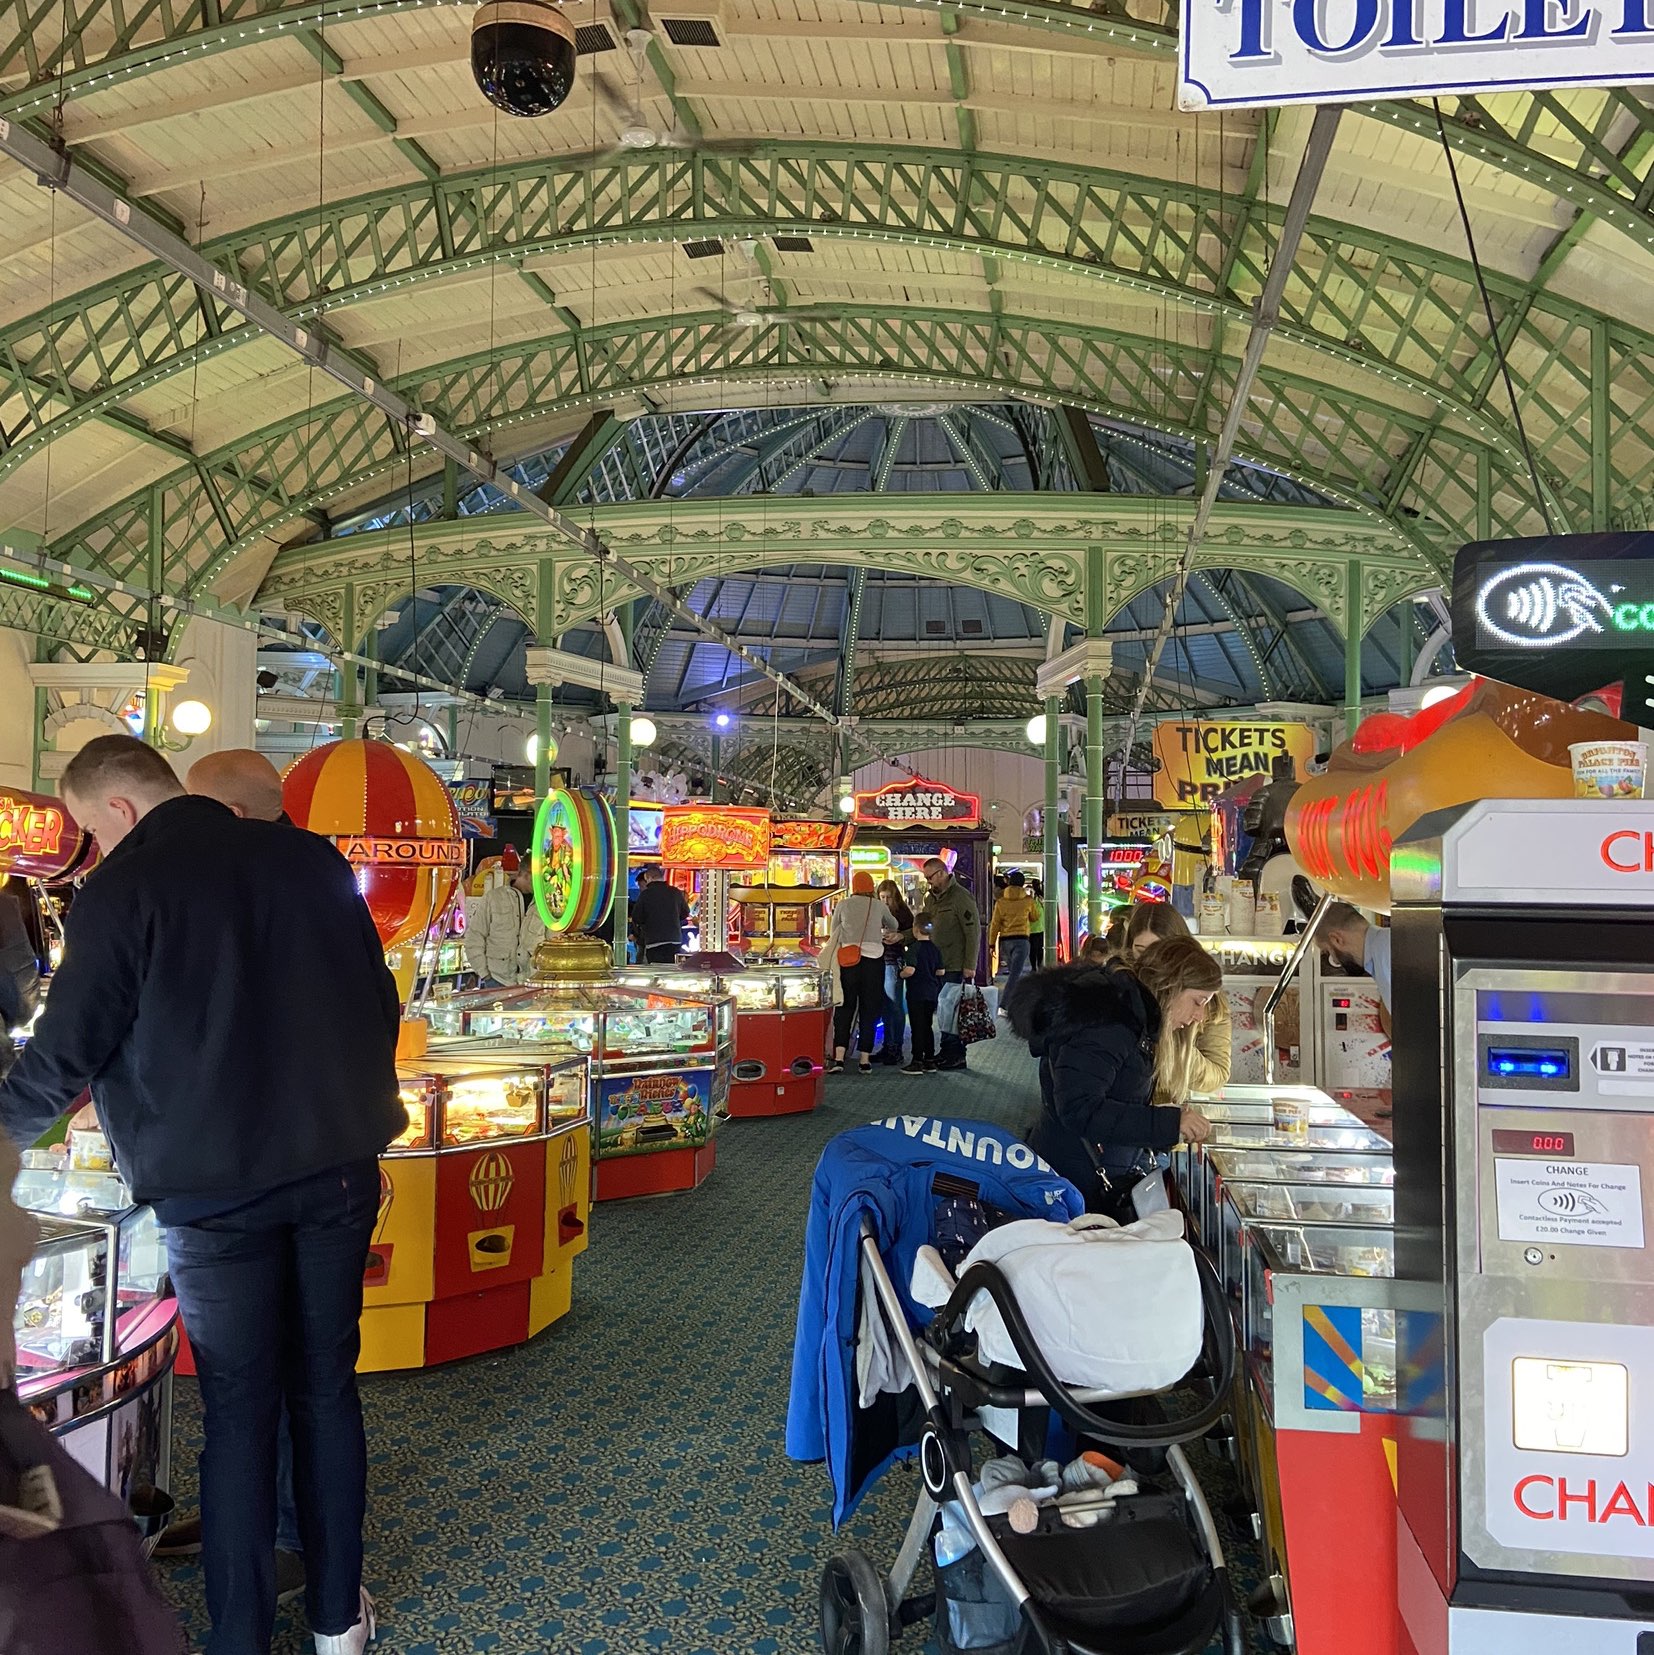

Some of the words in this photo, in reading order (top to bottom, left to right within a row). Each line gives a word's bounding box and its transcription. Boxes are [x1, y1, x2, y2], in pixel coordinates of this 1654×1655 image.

[1176, 727, 1286, 754] TICKETS
[1205, 752, 1270, 778] MEAN
[875, 793, 956, 807] CHANGE
[887, 807, 943, 820] HERE
[1117, 816, 1172, 830] TICKETS
[347, 843, 461, 860] AROUND
[1110, 850, 1143, 862] 1000
[1546, 1165, 1589, 1175] CHANGE
[1519, 1214, 1558, 1222] Contactless
[1560, 1227, 1585, 1235] Change
[1513, 1474, 1654, 1526] CHA
